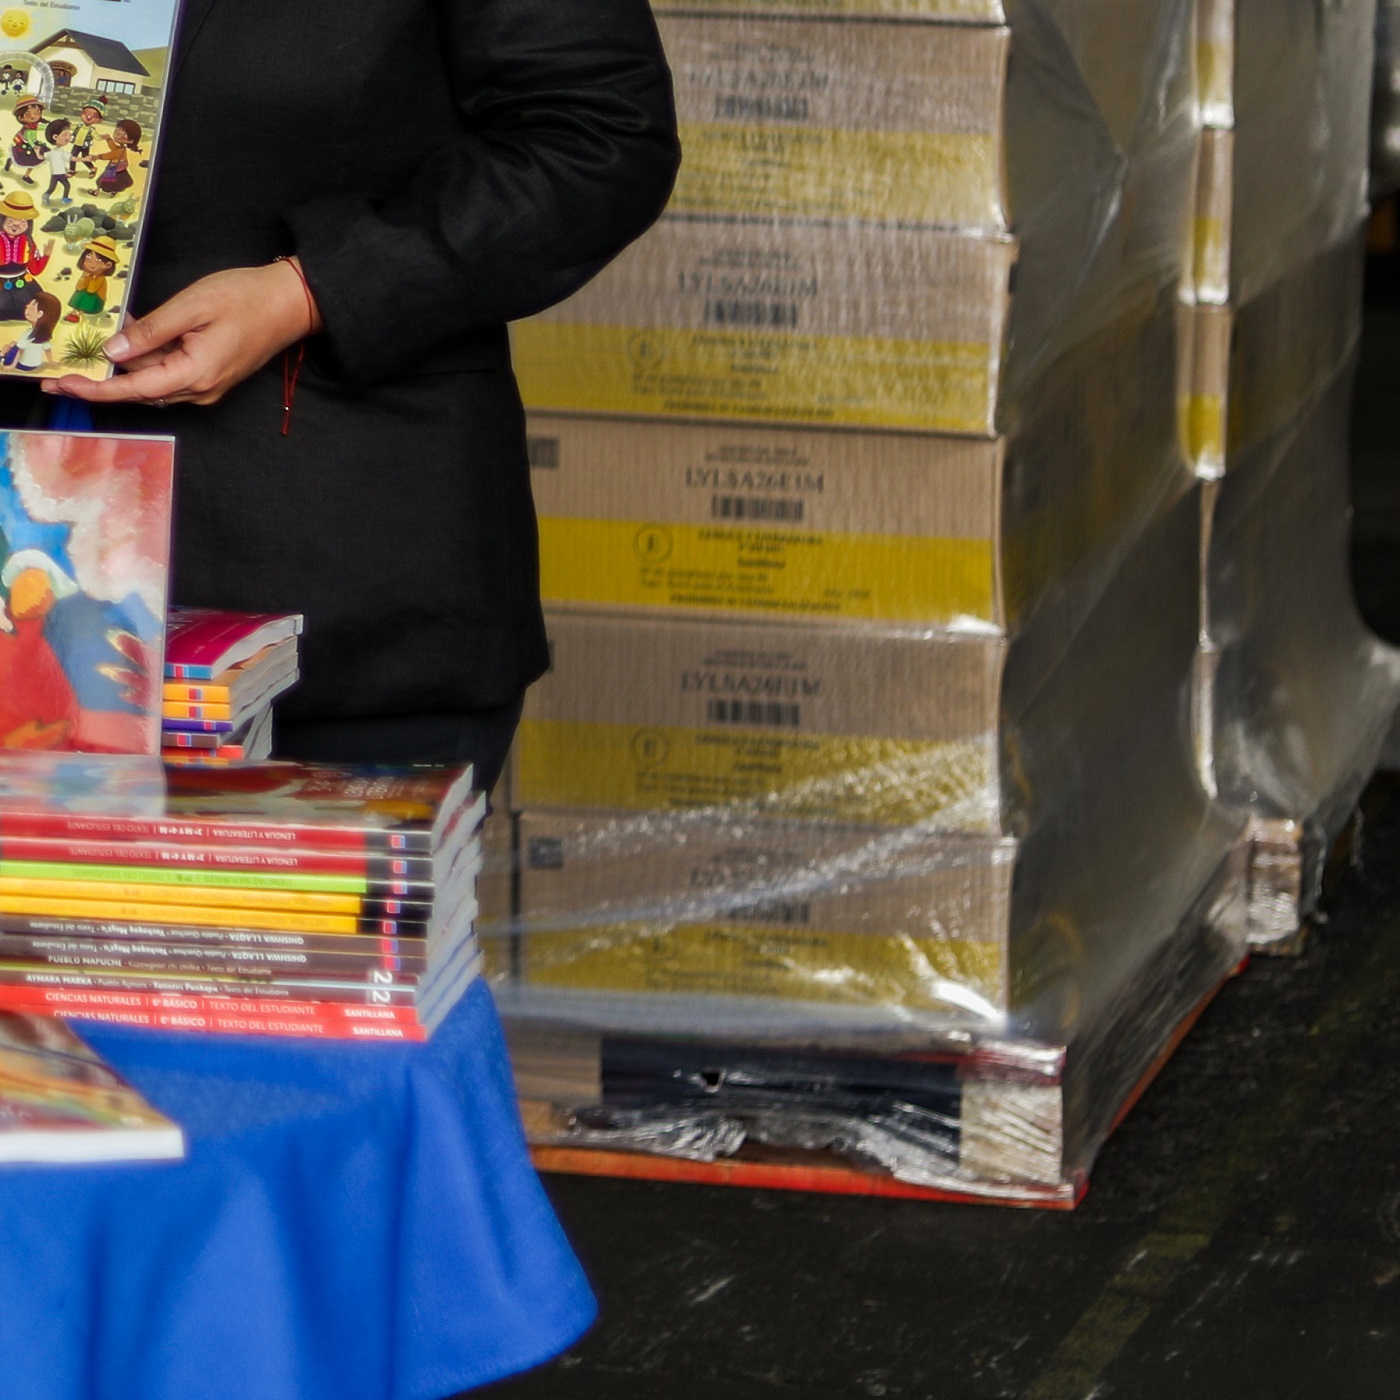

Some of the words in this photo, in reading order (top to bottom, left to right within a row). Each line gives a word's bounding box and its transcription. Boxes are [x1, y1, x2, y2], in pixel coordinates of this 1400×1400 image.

[213, 828, 259, 840] LITERATURA
[267, 831, 296, 841] LENGUA
[215, 854, 261, 865] LITERATURA
[269, 856, 298, 866] LENGUA
[48, 955, 81, 965] PUEBLO
[83, 957, 122, 967] MAPUCHE
[231, 950, 264, 961] LLAQTA
[266, 952, 307, 963] QHISHWA
[26, 973, 61, 983] AYMARA
[62, 975, 92, 985] MARKA
[45, 992, 87, 1003] CIENCIAS
[89, 994, 141, 1006] NATURALES
[163, 997, 197, 1009] BÁSICO
[210, 1002, 239, 1012] TEXTO
[241, 1003, 259, 1013] DEL
[260, 1004, 316, 1016] ESTUDIANTE
[344, 1008, 395, 1019] SANTILLANA
[99, 1012, 149, 1024] NATURALES
[170, 1016, 206, 1027] BÁSICO
[217, 1019, 247, 1029] TEXTO
[249, 1021, 267, 1030] DEL
[268, 1022, 324, 1034] ESTUDIANTE
[352, 1026, 404, 1038] SANTILLANA
